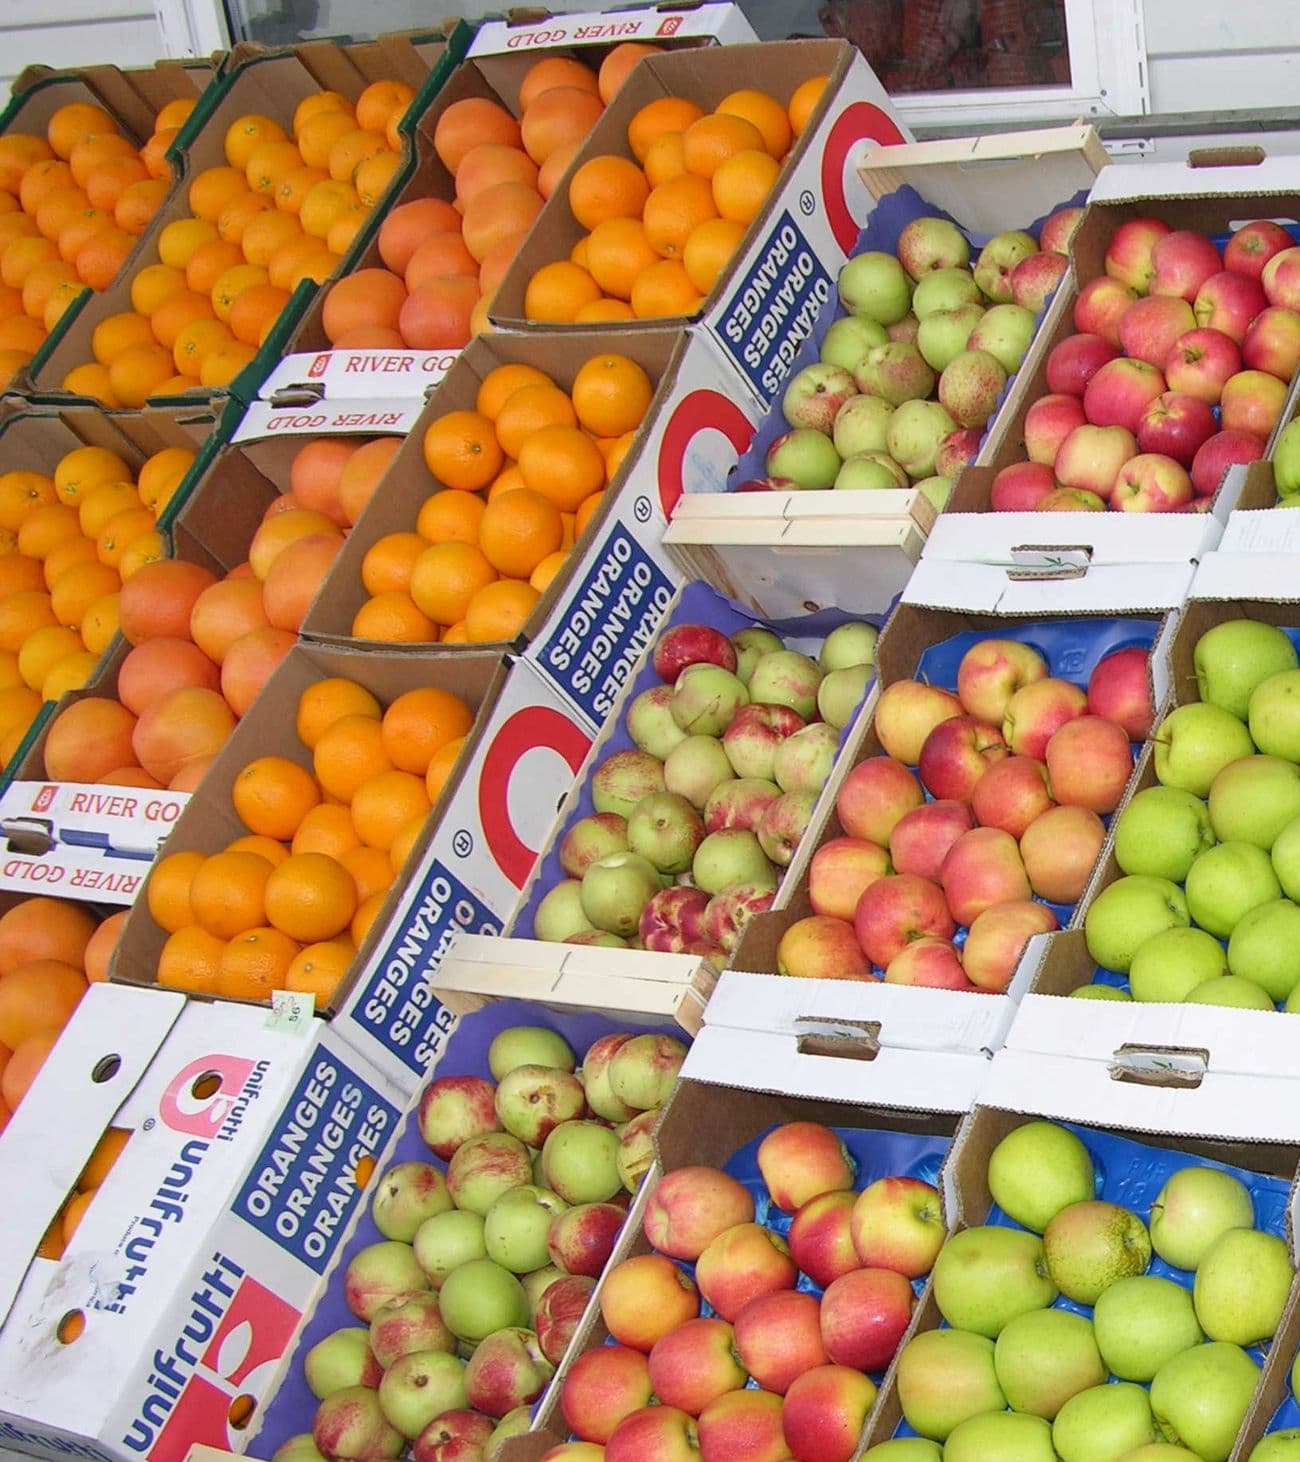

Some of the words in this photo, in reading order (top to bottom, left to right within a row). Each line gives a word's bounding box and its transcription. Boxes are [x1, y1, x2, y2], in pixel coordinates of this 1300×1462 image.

[507, 29, 567, 48] GOLD
[573, 21, 643, 39] RIVER
[725, 225, 798, 343] ORANGES
[743, 251, 814, 369] ORANGES
[266, 415, 328, 430] GOLD
[332, 412, 404, 425] RIVER
[345, 356, 415, 373] RIVER
[421, 356, 457, 372] GO
[550, 537, 632, 671] ORANGES
[571, 562, 651, 694] ORANGES
[593, 586, 672, 718] ORANGES
[70, 793, 138, 818] RIVER
[144, 800, 181, 822] GO
[3, 860, 65, 883] GOLD
[69, 869, 143, 894] RIVER
[364, 877, 452, 1024] ORANGES
[217, 1060, 271, 1142] unifrutti
[247, 1061, 337, 1218] ORANGES
[275, 1083, 363, 1238] ORANGES
[304, 1104, 388, 1259] ORANGES
[122, 1252, 245, 1452] unifrutti
